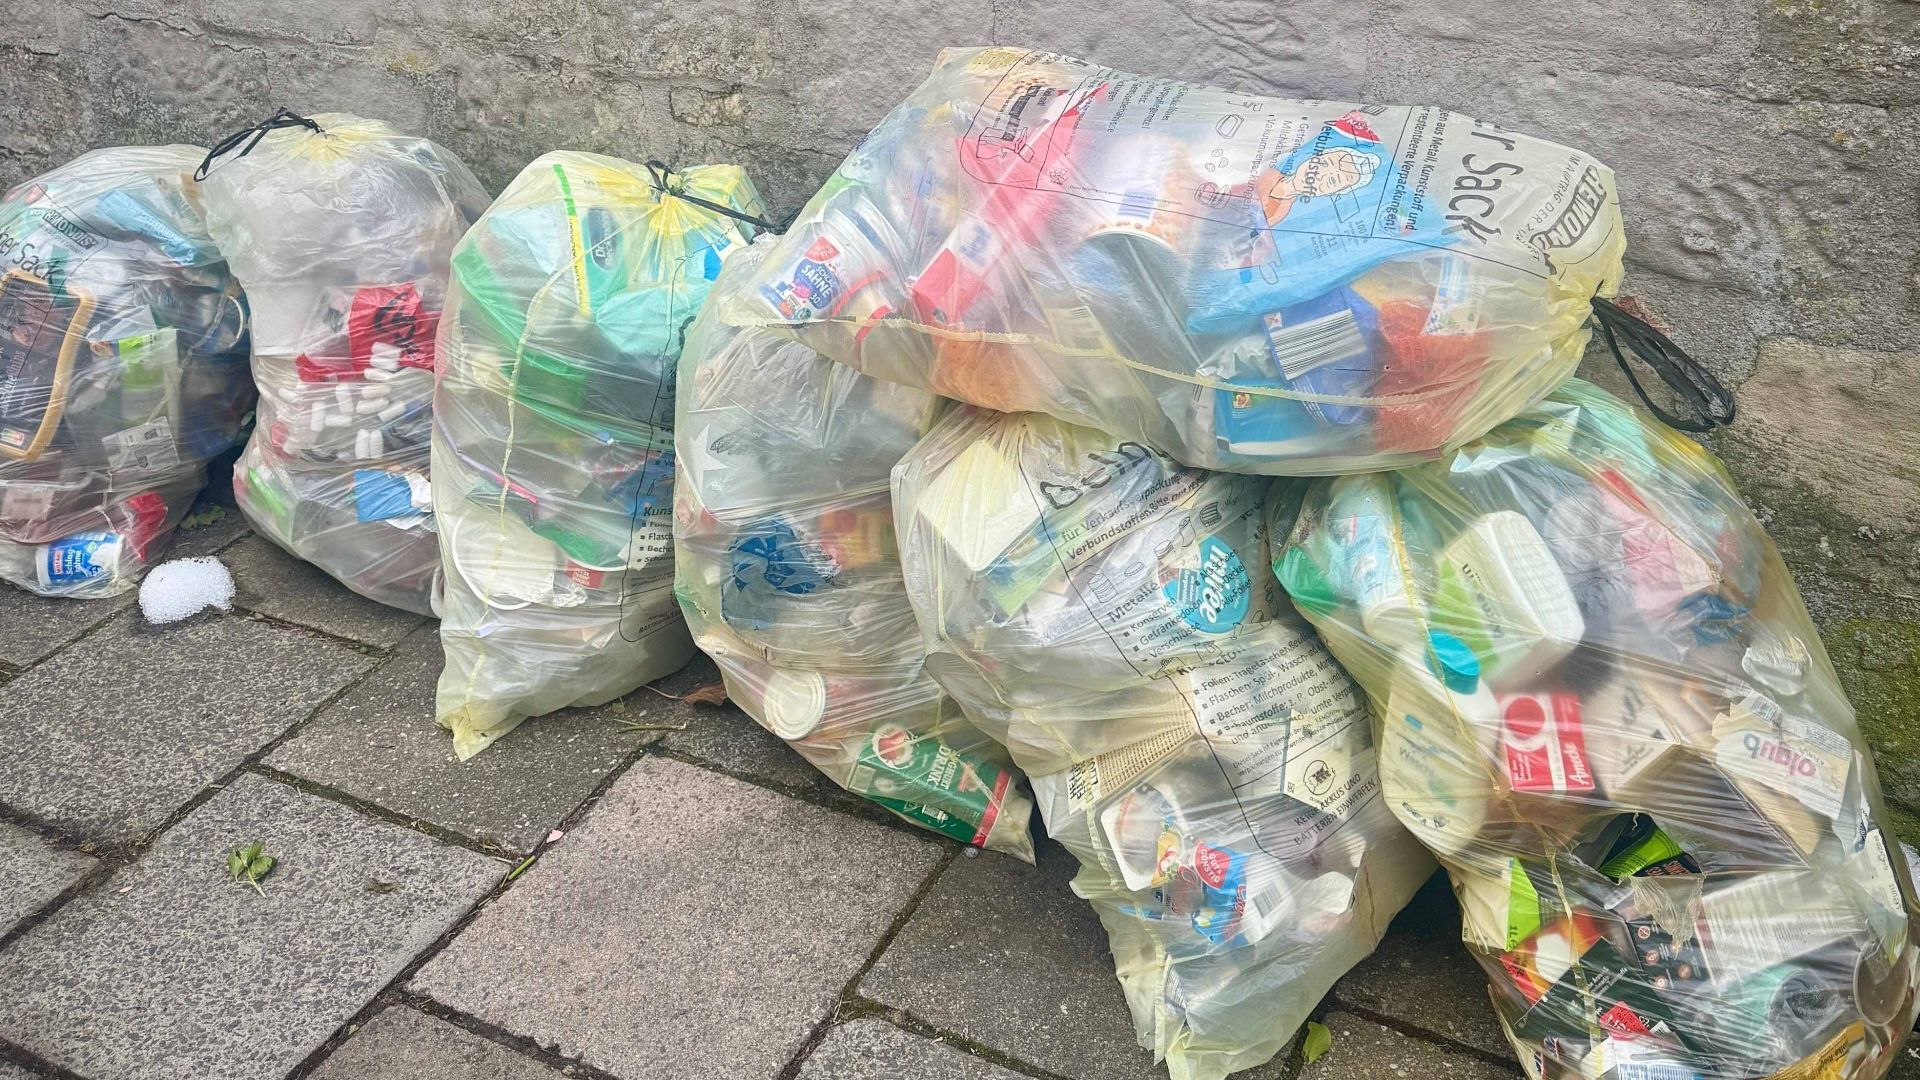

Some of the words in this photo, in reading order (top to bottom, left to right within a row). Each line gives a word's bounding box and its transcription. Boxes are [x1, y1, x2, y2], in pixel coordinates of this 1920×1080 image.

[1434, 122, 1446, 135] aus
[1383, 161, 1416, 231] Verpackungen!
[1414, 165, 1435, 212] Kunststoff
[1441, 153, 1524, 245] Sack
[1405, 212, 1418, 230] und
[1532, 201, 1555, 224] DER
[12, 242, 64, 285] Sack
[801, 264, 831, 298] SAHNE
[1061, 528, 1081, 543] für
[1107, 580, 1161, 623] Metalle
[1130, 597, 1177, 632] Konserven
[1139, 599, 1203, 646] Getränkedosen
[1149, 621, 1201, 658] Verschlüsse
[1201, 674, 1234, 691] Folien:
[1209, 681, 1255, 706] Flaschen:
[1216, 701, 1255, 722] Becher:
[1253, 668, 1319, 705] Milchprodukte,
[1308, 680, 1330, 698] Obst-
[1320, 786, 1345, 810] AKKUS
[1343, 773, 1361, 791] UND
[1294, 811, 1338, 845] BATTERIEN
[1336, 779, 1376, 815] EINWERFEN
